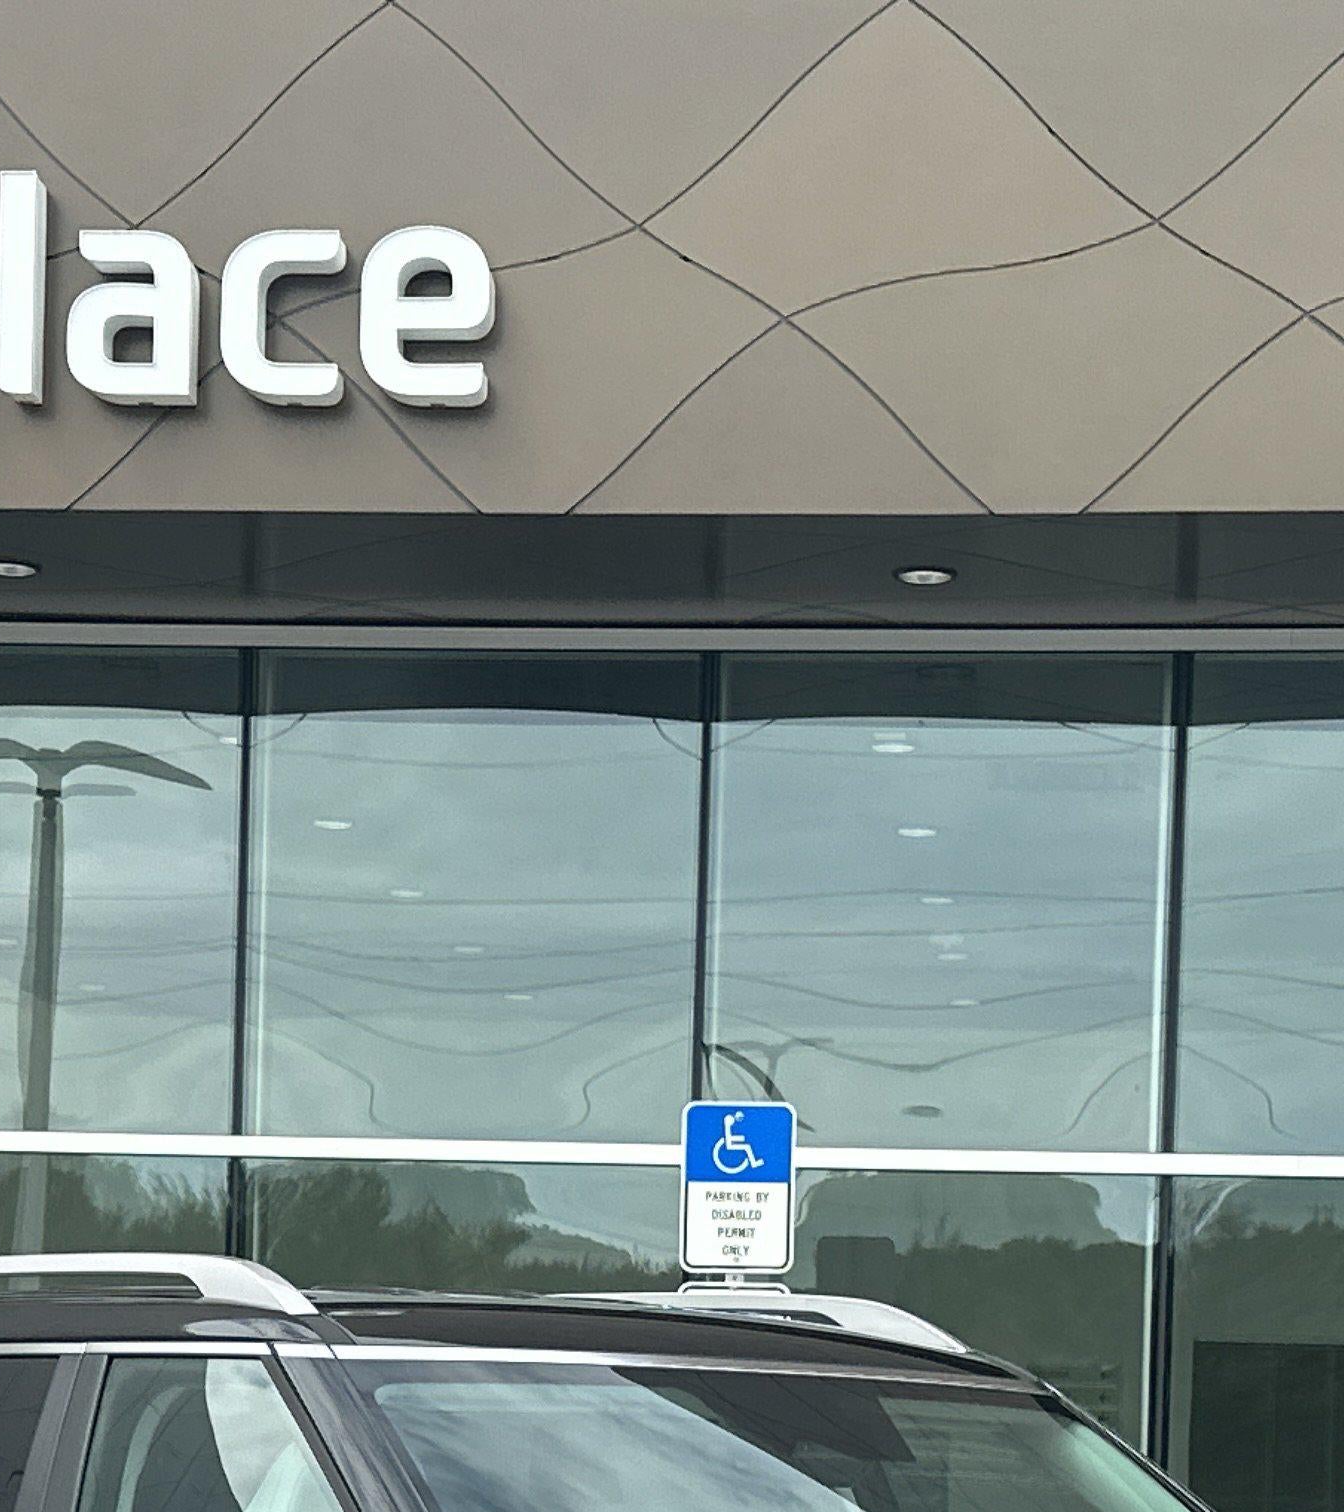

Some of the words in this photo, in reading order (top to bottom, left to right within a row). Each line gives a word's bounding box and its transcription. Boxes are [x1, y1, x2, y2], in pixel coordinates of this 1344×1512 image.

[705, 1190, 750, 1202] PARKING
[756, 1191, 769, 1203] BY
[711, 1208, 762, 1221] DISABLED
[717, 1227, 755, 1238] PERMIT
[721, 1244, 750, 1256] ONLY
